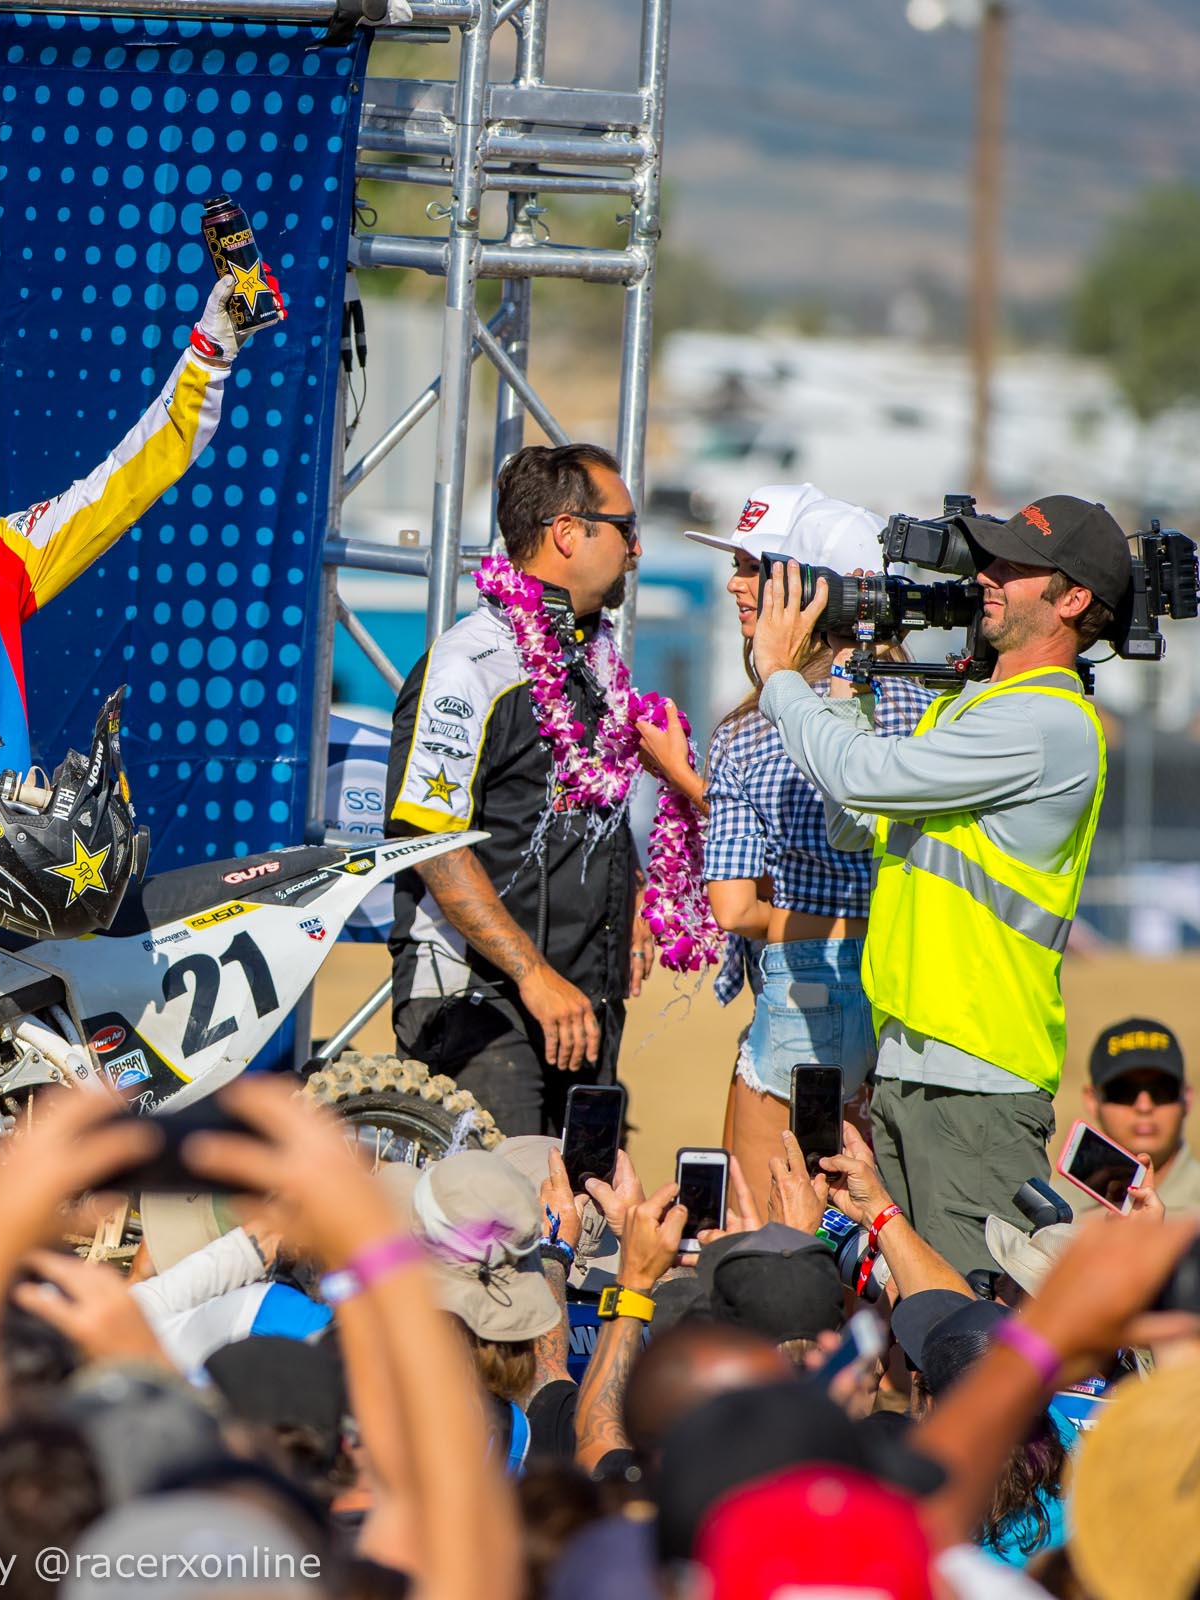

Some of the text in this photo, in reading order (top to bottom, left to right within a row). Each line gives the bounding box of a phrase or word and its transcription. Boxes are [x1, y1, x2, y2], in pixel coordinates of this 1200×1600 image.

[220, 229, 253, 248] ROCKS
[438, 698, 470, 718] Airoh
[87, 740, 104, 788] Airoh
[382, 832, 464, 862] DUNLOP
[221, 861, 281, 885] GUTS
[285, 872, 330, 896] SCOSCHE
[152, 928, 189, 948] Husqvarna
[162, 930, 280, 1059] 21
[94, 1029, 123, 1049] Twin Air
[1108, 1032, 1169, 1056] SHERIFF
